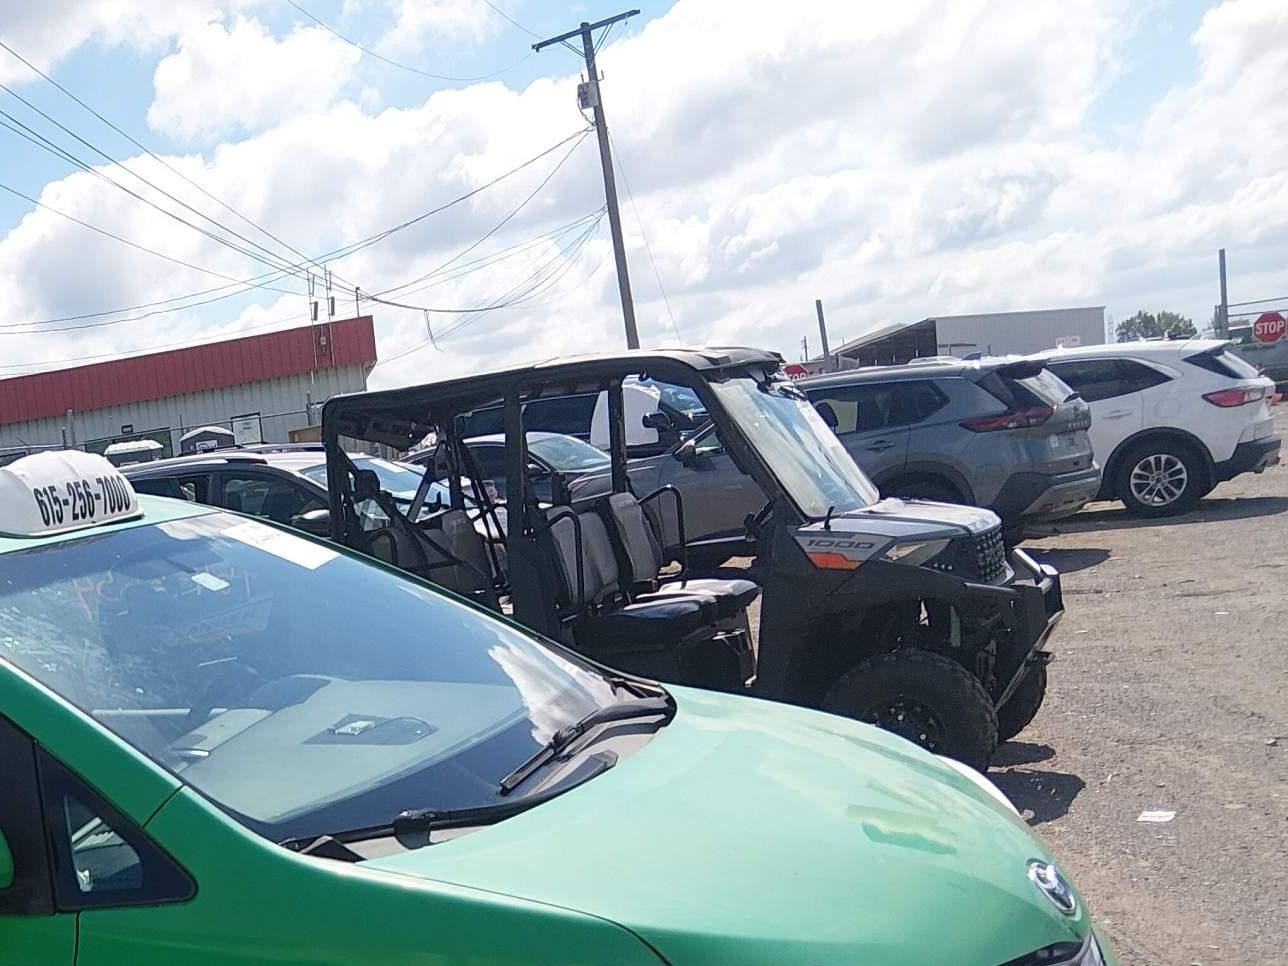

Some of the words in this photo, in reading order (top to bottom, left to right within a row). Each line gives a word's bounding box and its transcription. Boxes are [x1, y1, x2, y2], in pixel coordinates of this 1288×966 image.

[1255, 320, 1285, 335] STOP
[33, 475, 131, 527] 615-256-7000
[807, 539, 876, 549] 1000
